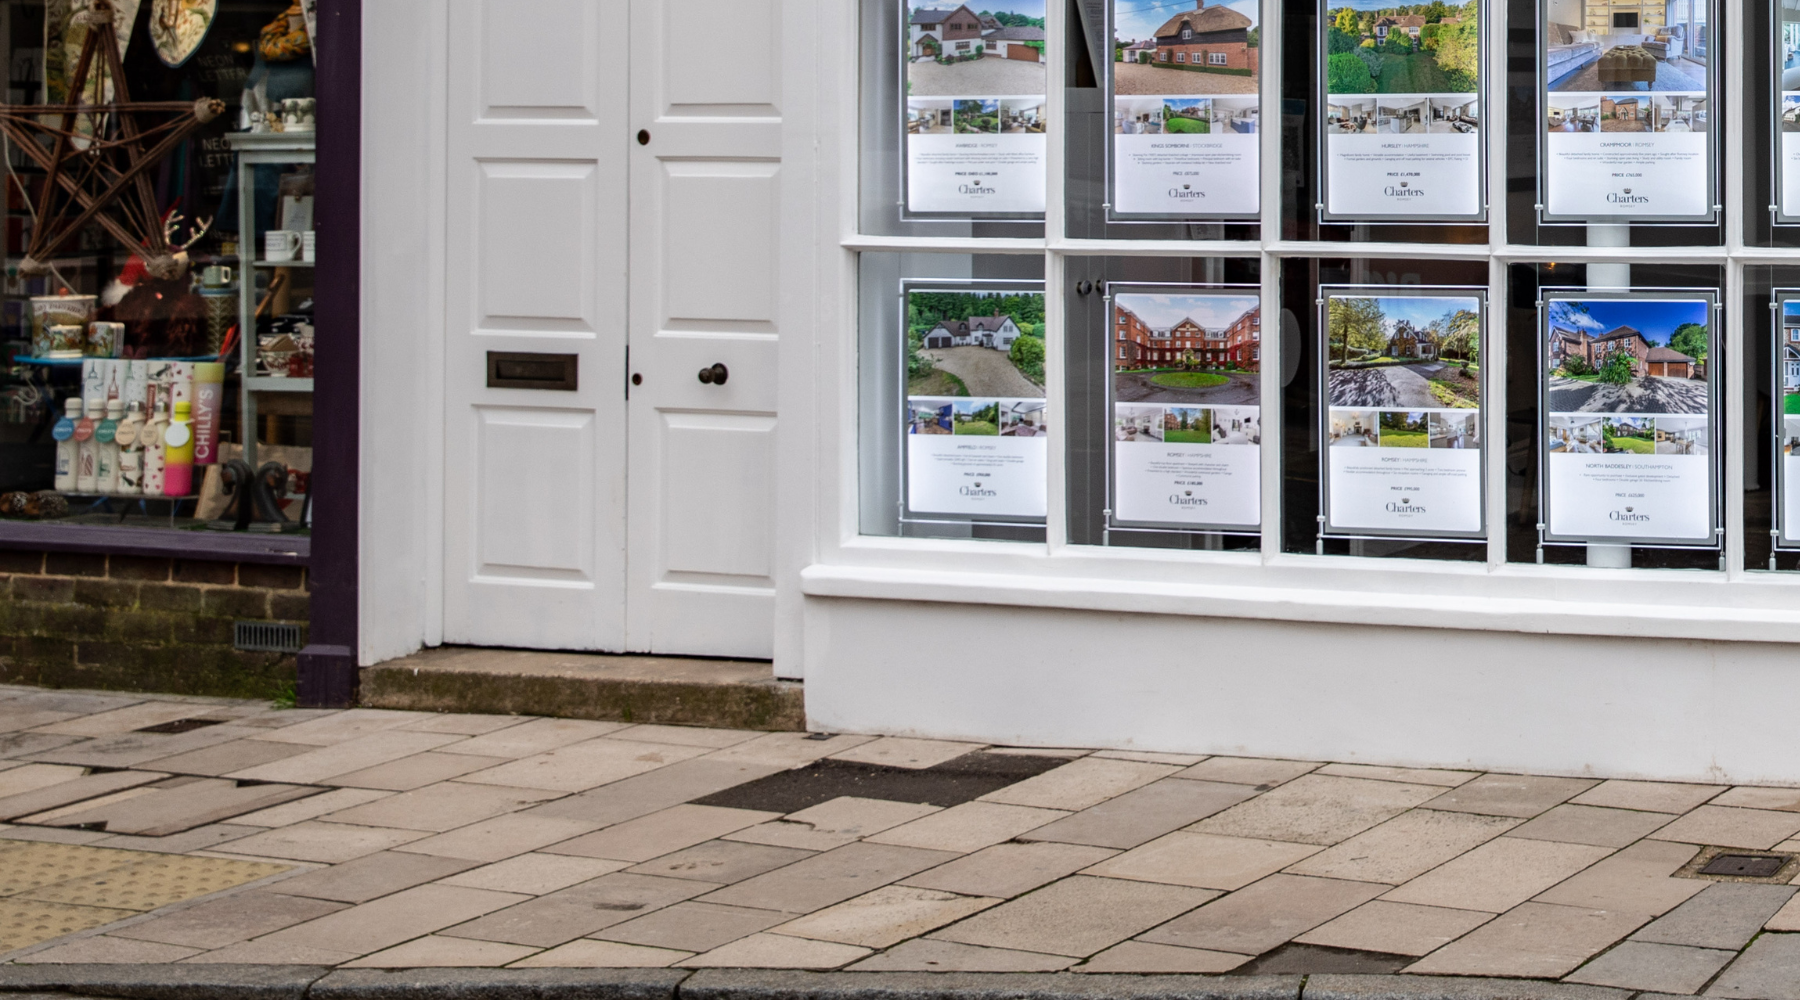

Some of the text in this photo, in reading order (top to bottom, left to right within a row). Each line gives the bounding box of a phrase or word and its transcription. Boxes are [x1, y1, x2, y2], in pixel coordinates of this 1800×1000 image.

[958, 184, 995, 194] Charters
[1168, 188, 1205, 198] Charters
[1384, 186, 1424, 196] Charters
[1606, 193, 1648, 203] Charters
[195, 389, 214, 459] CHILLY'S
[959, 486, 996, 496] Charters
[1169, 494, 1207, 505] Charters
[1386, 502, 1426, 513] Charters
[1609, 511, 1650, 521] Charters
